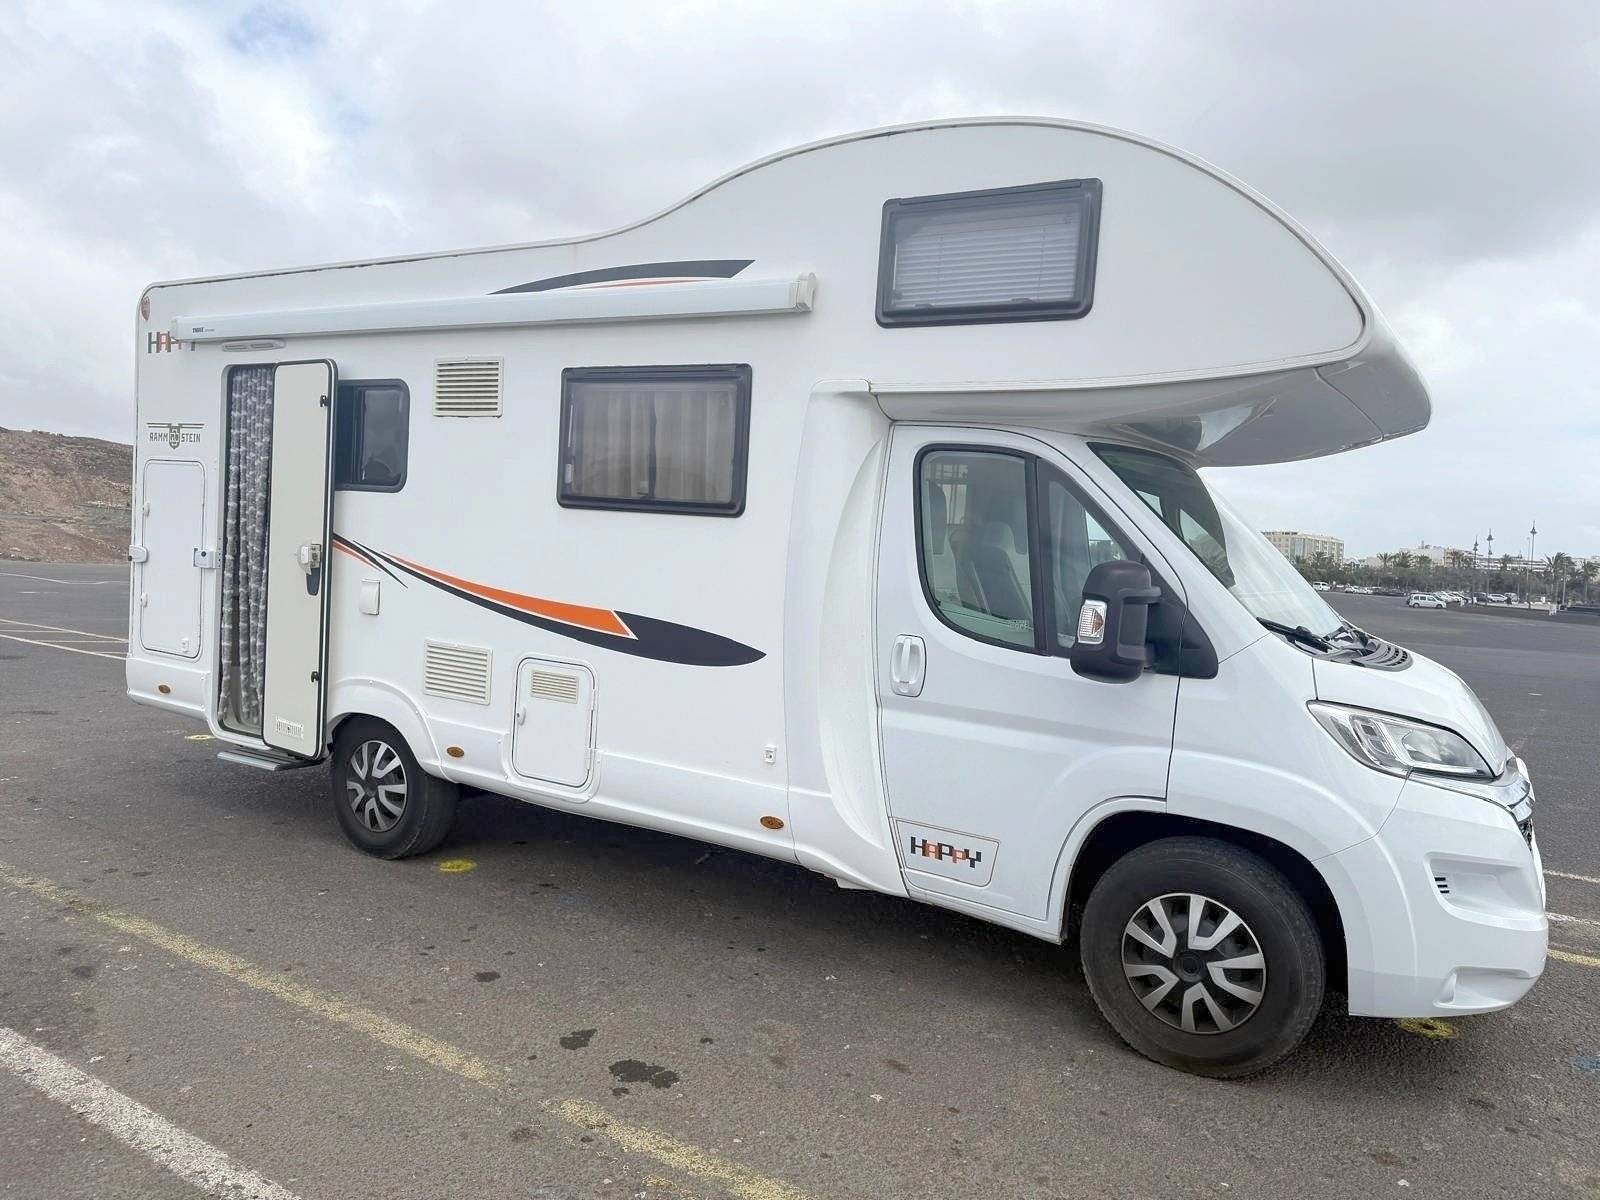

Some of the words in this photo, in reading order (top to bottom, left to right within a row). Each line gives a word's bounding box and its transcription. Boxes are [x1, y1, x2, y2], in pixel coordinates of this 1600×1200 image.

[149, 432, 169, 442] RAMM
[181, 433, 201, 443] STEIN
[910, 836, 982, 869] HAPPY
